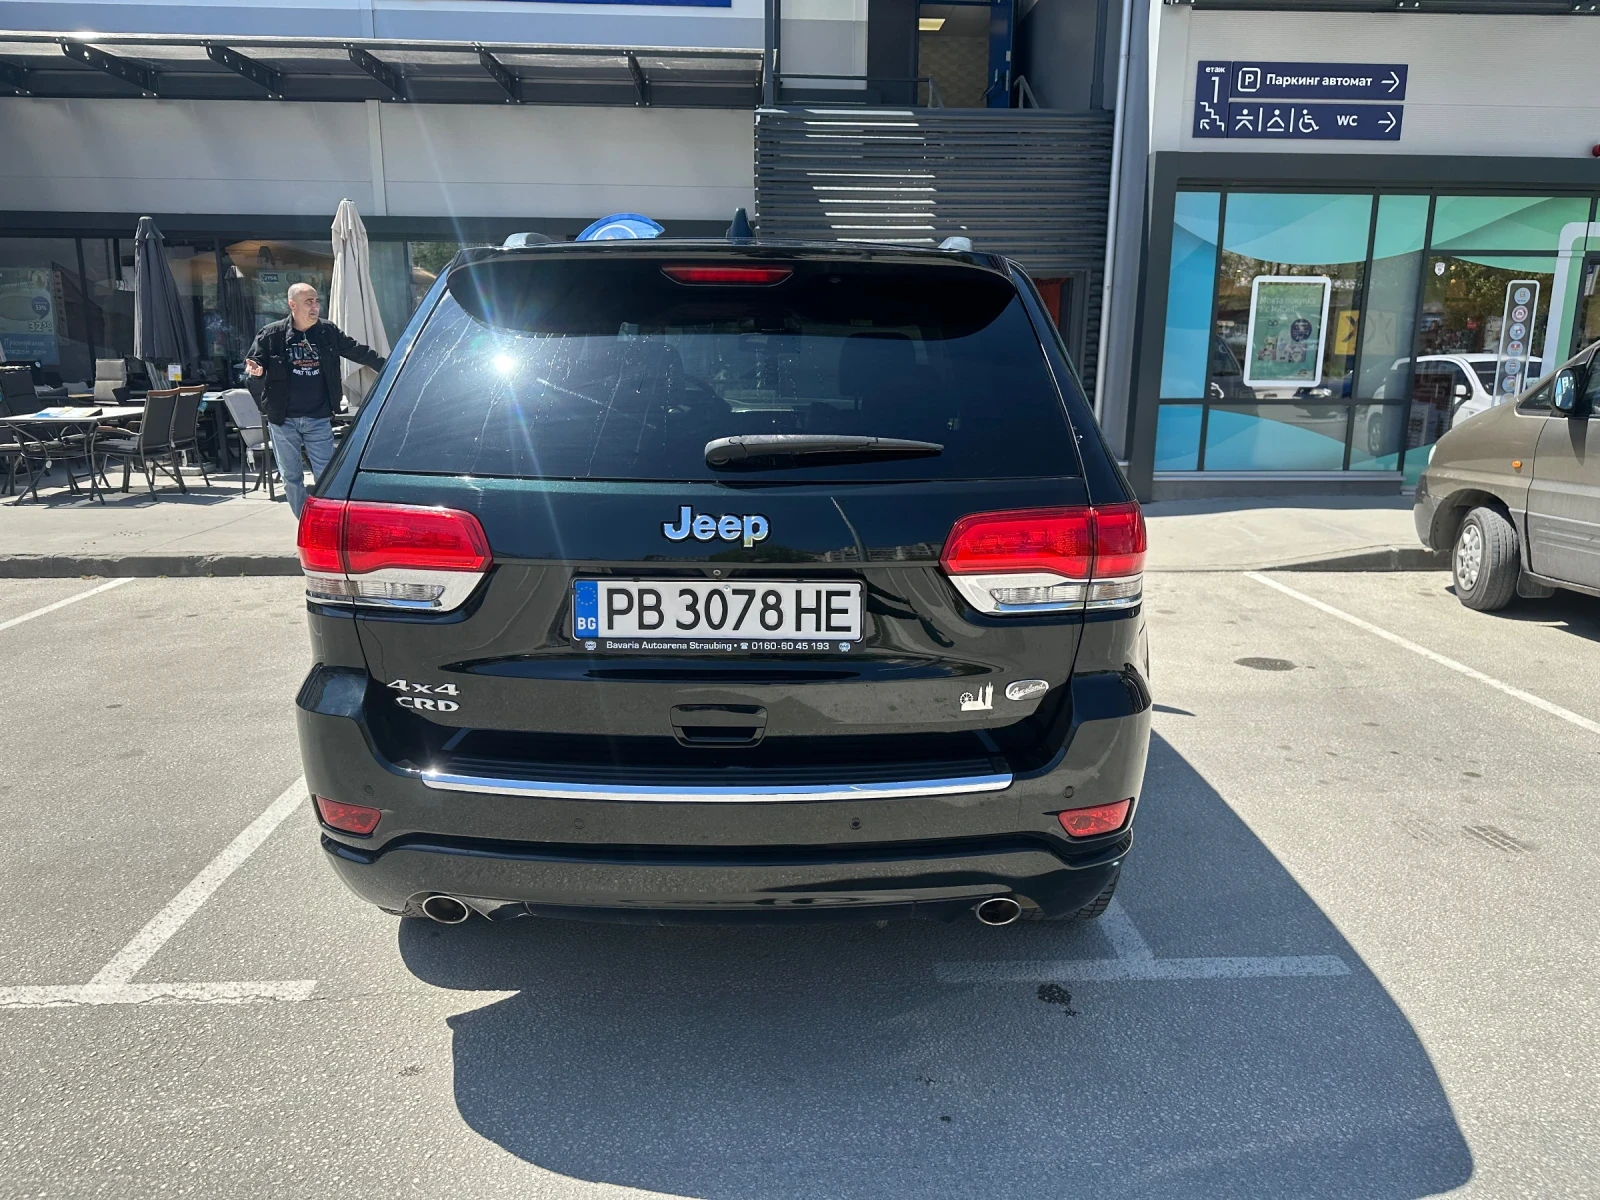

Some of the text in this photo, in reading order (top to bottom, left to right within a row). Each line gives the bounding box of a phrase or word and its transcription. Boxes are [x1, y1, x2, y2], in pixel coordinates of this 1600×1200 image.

[1266, 74, 1320, 88] Паркинг
[1322, 77, 1373, 87] автомат
[1211, 76, 1220, 103] 1
[1337, 115, 1358, 126] WC
[663, 506, 769, 548] Jeep
[606, 588, 852, 632] PB 3078 HE
[577, 617, 597, 630] BG
[606, 641, 640, 650] Bavaria
[642, 641, 687, 650] Autoarena
[689, 641, 732, 651] Straubing
[752, 642, 793, 650] 0160-60
[796, 642, 808, 650] 45
[811, 642, 830, 650] 193
[387, 679, 461, 696] 4x4
[395, 696, 460, 712] CRD
